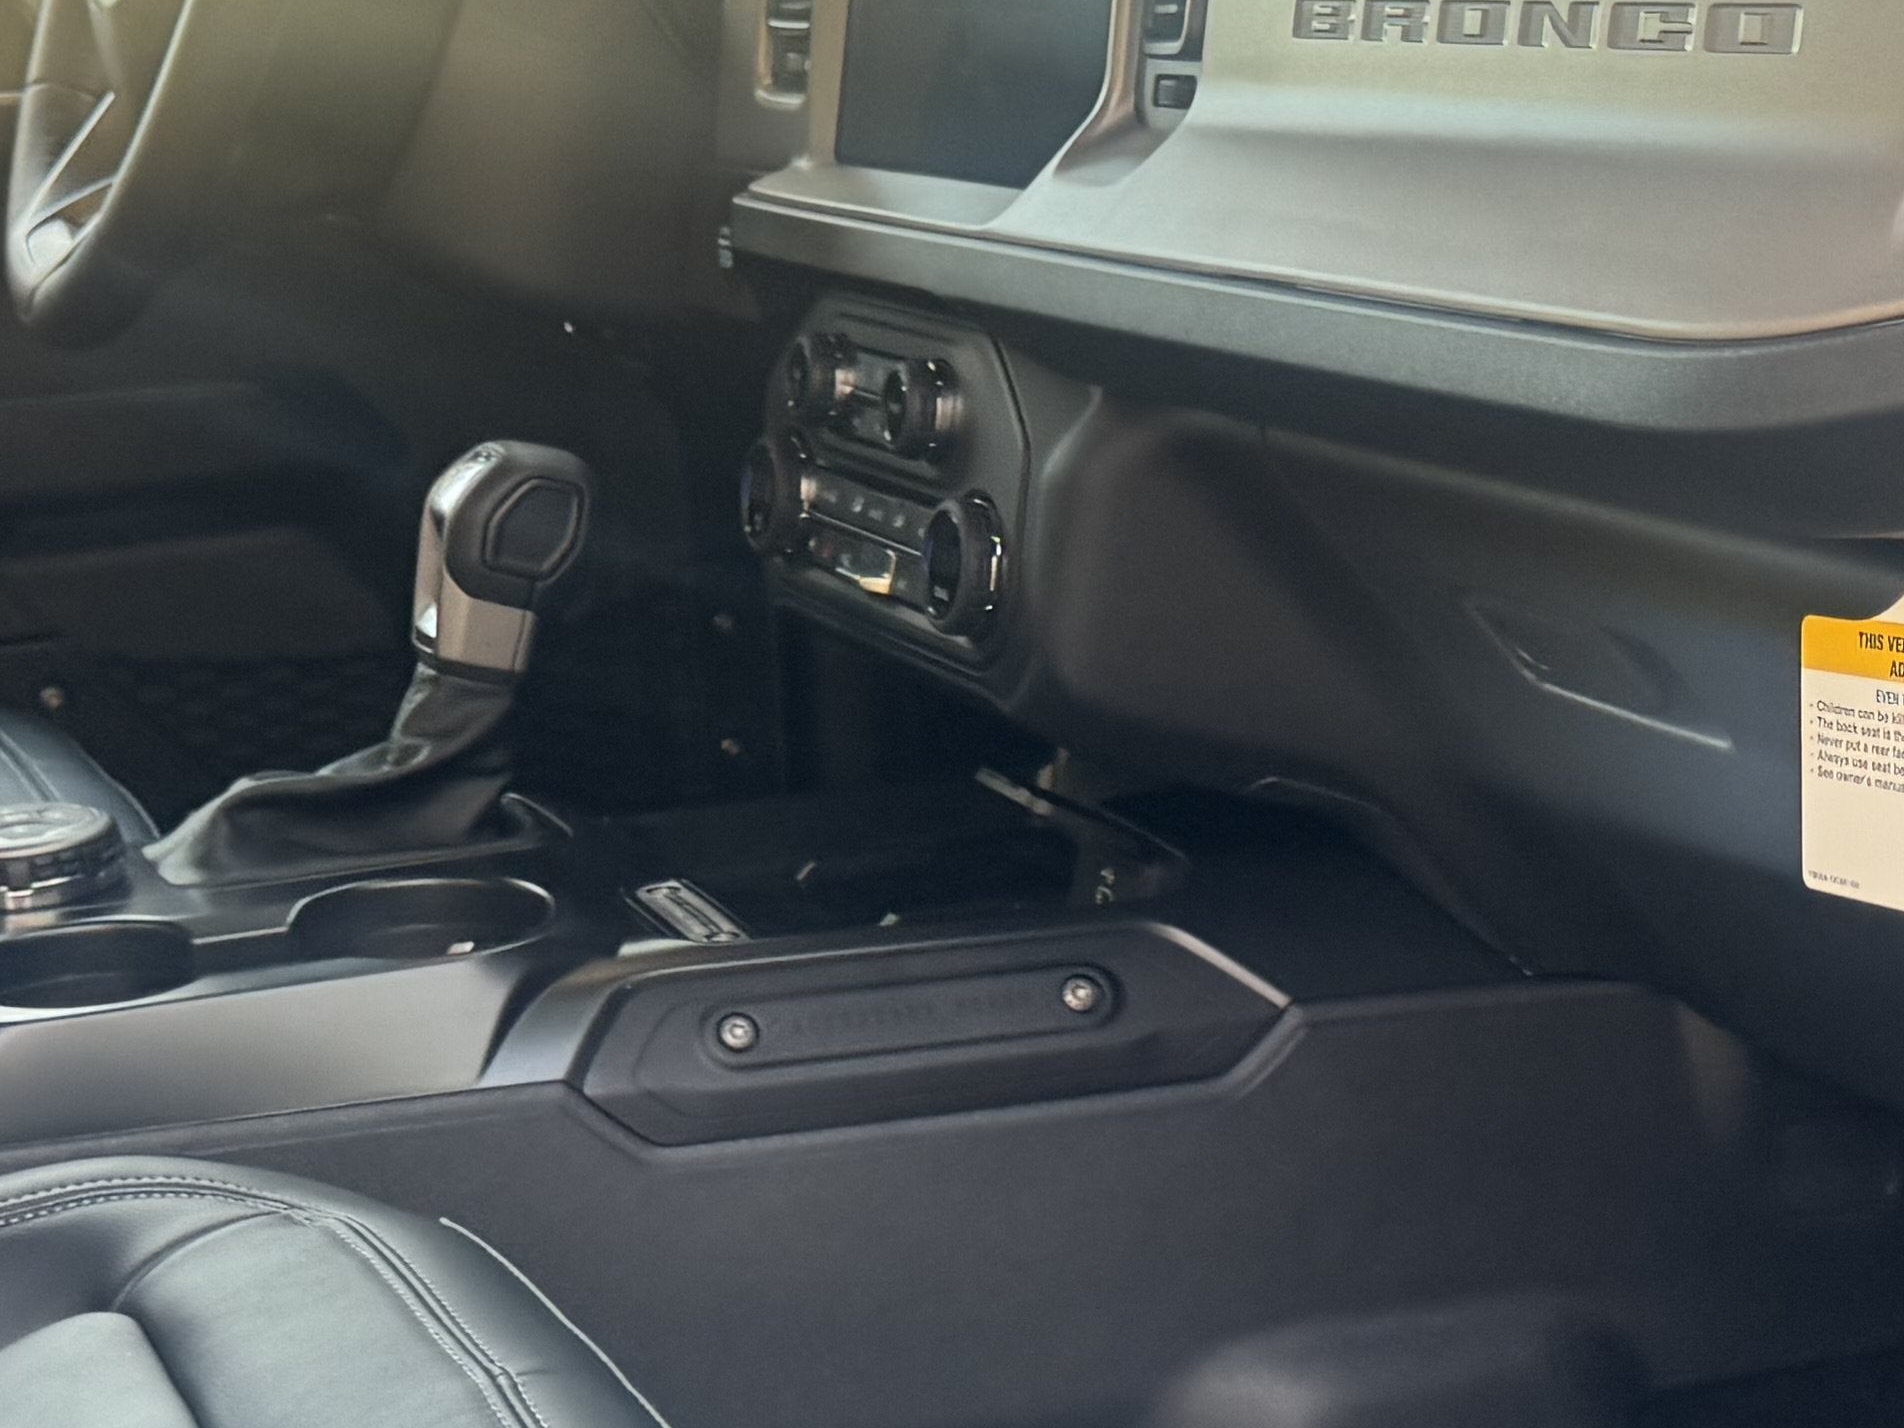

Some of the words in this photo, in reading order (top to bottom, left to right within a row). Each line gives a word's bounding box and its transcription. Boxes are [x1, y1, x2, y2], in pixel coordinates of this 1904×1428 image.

[1859, 631, 1884, 650] THIS
[1876, 689, 1898, 705] EVEN
[1816, 700, 1855, 716] Children
[1858, 710, 1875, 720] can
[1817, 716, 1833, 730] The
[1837, 721, 1858, 734] back
[1861, 726, 1880, 738] seat
[1817, 734, 1843, 748] Never
[1847, 740, 1861, 752] put
[1872, 745, 1890, 757] rear
[1817, 750, 1849, 767] Always
[1852, 759, 1868, 770] use
[1872, 760, 1890, 773] seat
[1817, 765, 1833, 779] See
